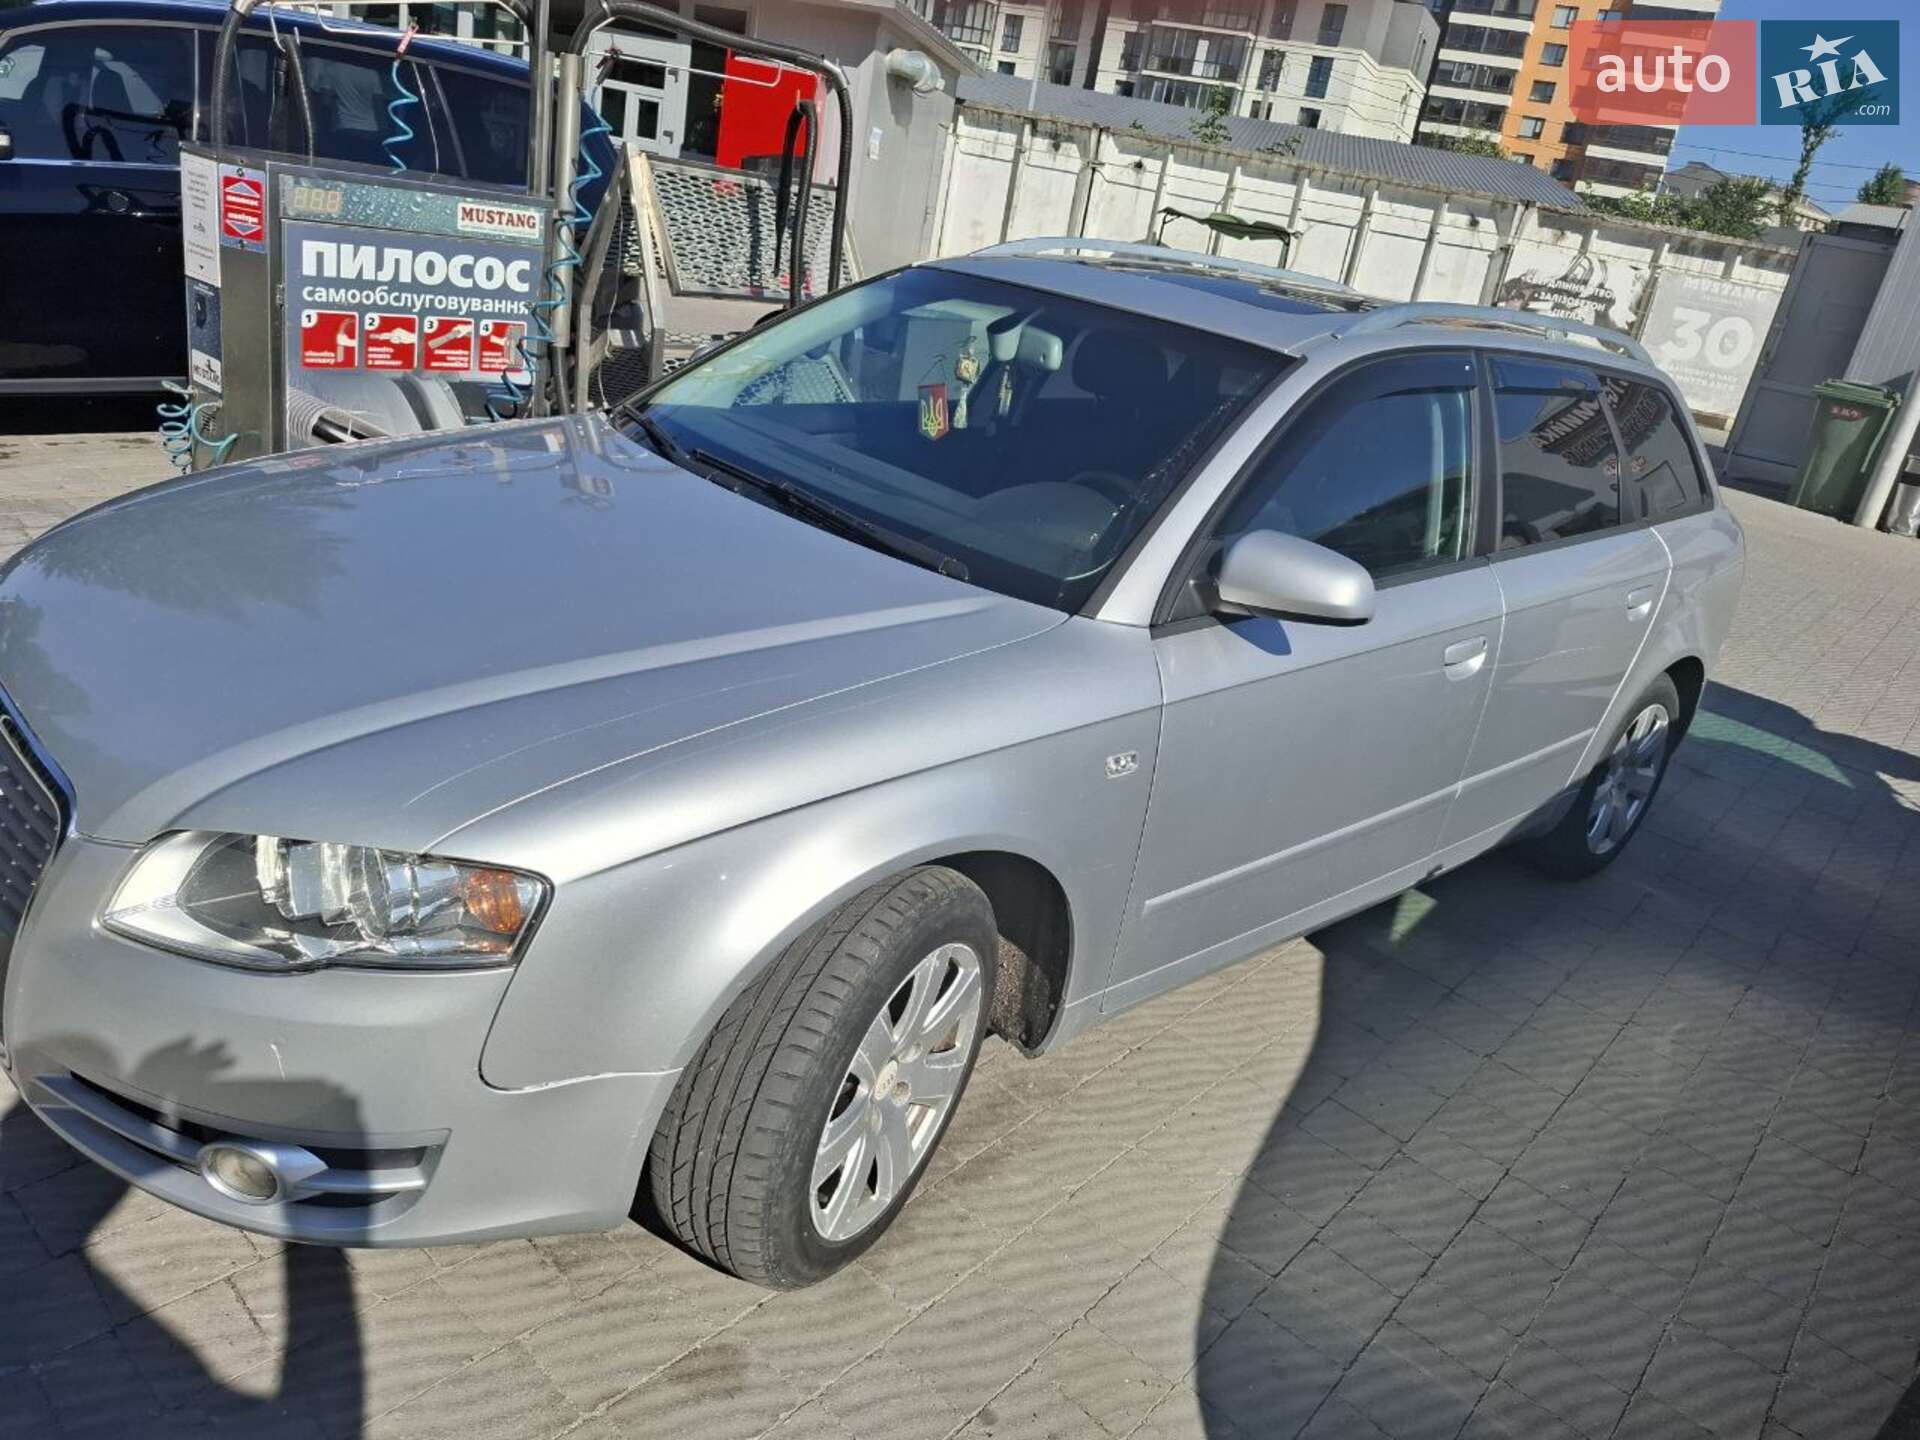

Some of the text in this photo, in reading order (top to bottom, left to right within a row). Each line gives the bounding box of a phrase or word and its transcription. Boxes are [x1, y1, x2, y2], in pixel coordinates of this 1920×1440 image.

[460, 206, 537, 230] MUSTANG
[302, 285, 530, 316] самообслуговування
[305, 314, 312, 323] 1
[368, 317, 375, 326] 2
[427, 320, 435, 329] 3
[482, 323, 489, 332] 4
[1660, 306, 1755, 369] 30
